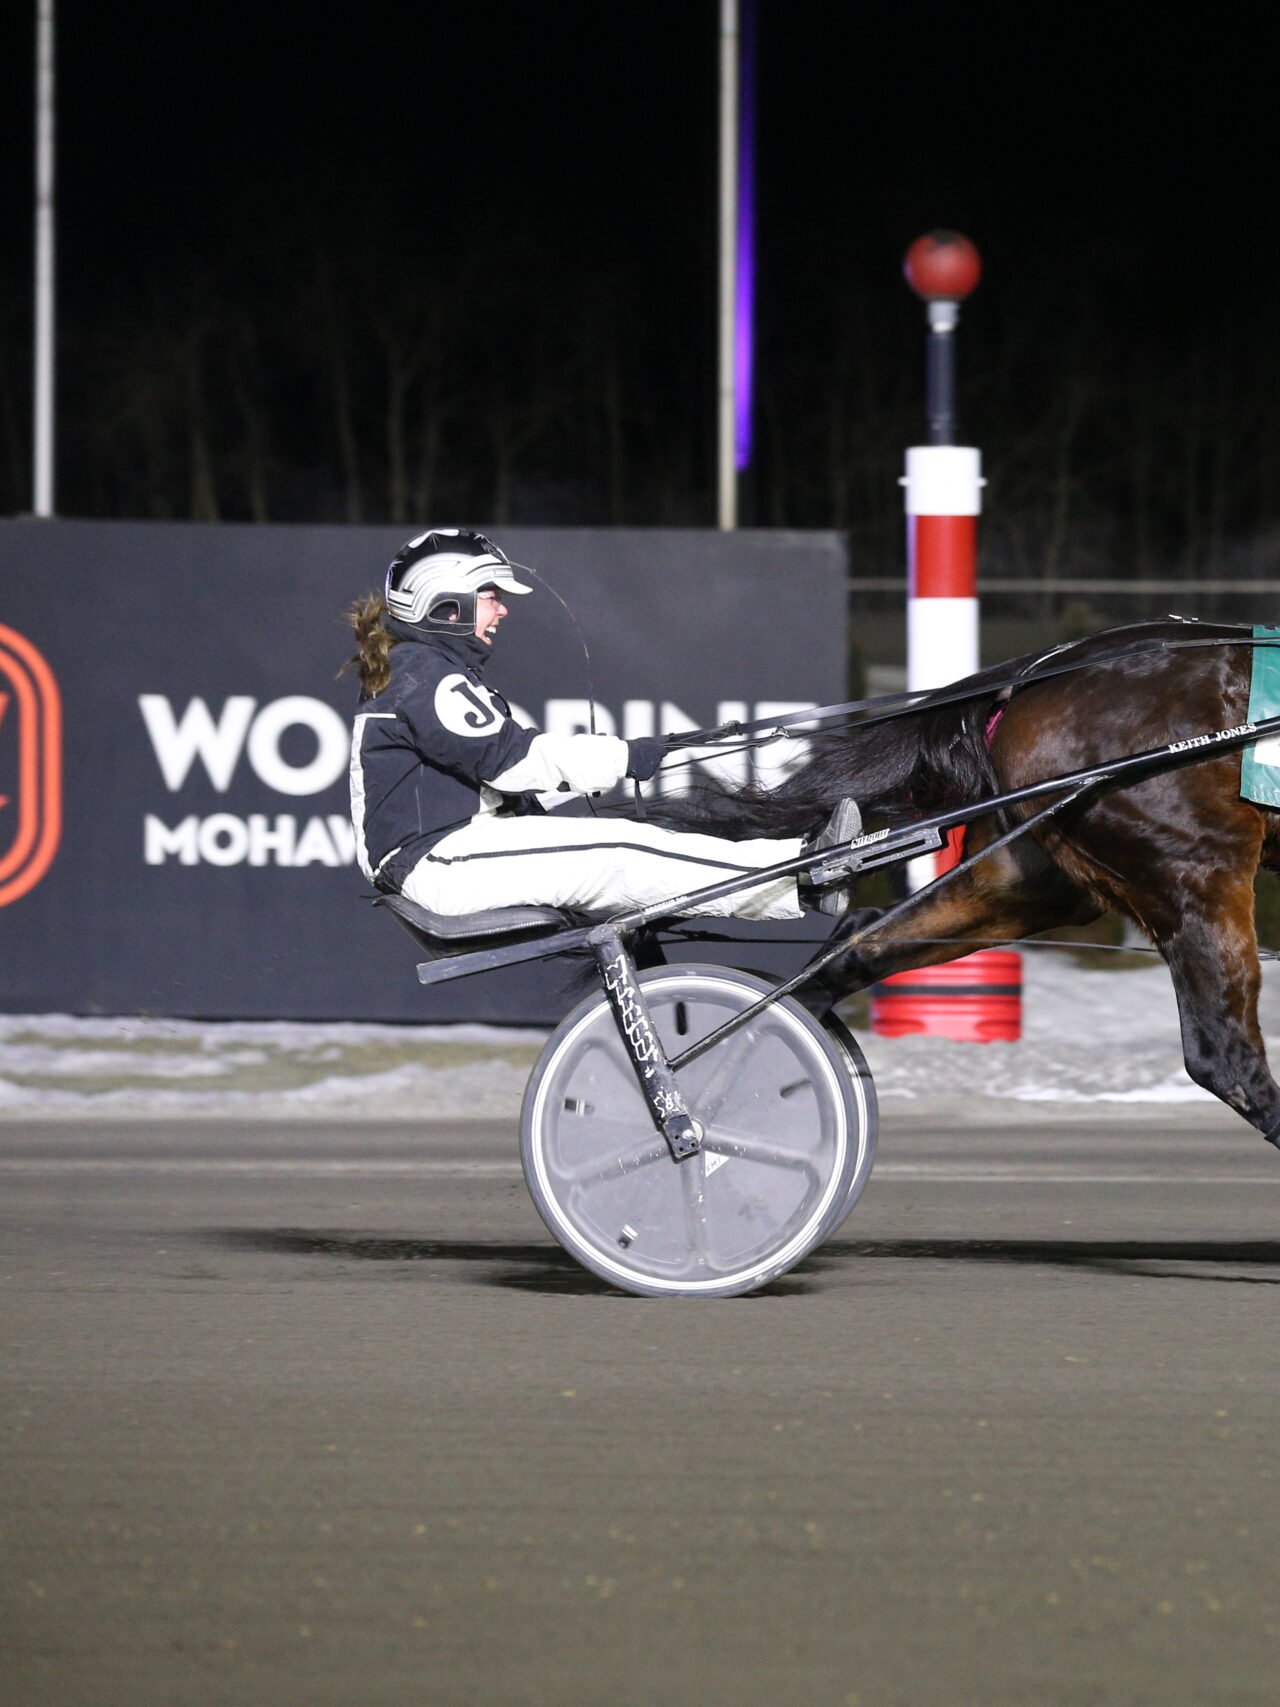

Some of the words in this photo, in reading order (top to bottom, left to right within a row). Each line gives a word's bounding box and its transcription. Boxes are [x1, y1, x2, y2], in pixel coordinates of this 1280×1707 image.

[138, 694, 822, 800] WOINE
[1168, 735, 1211, 754] KEITH
[1215, 723, 1257, 742] JONES
